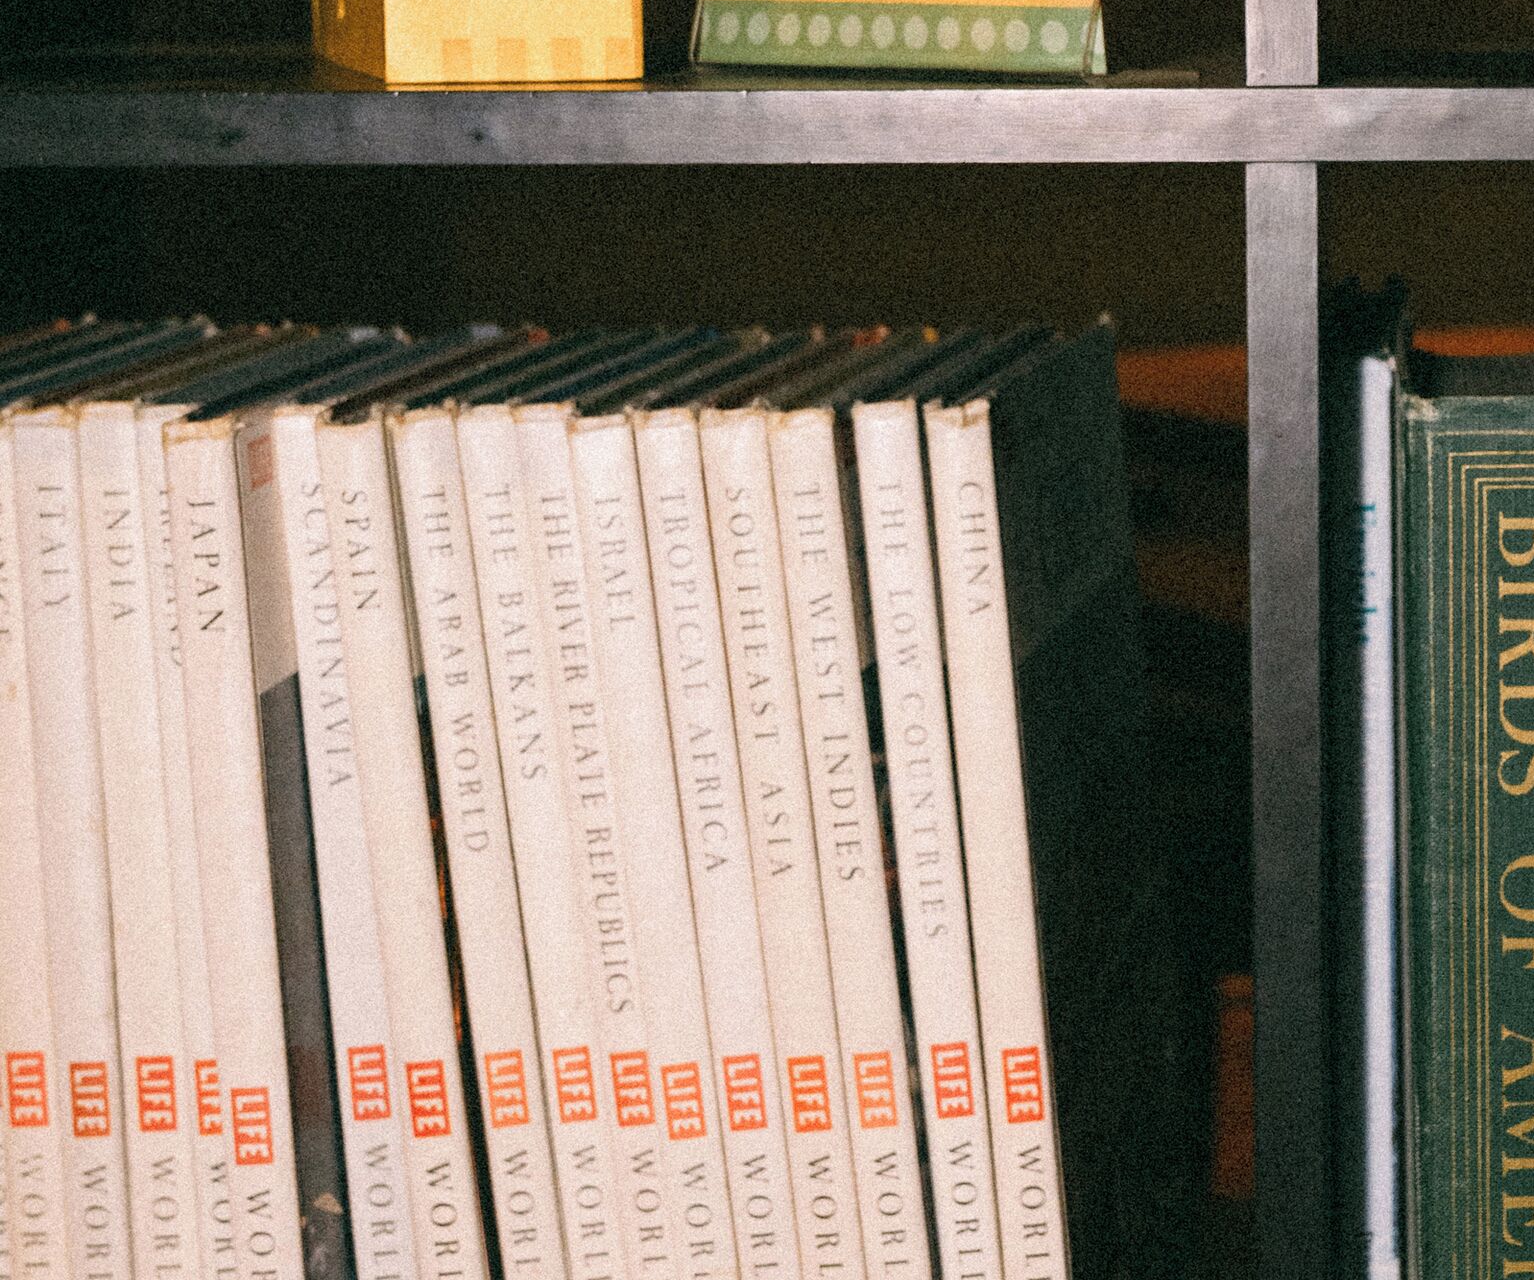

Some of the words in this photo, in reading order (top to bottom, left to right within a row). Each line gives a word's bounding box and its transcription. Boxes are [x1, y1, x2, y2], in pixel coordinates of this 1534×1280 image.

[36, 483, 72, 608] ITALY
[102, 488, 138, 622] INDIA
[186, 499, 227, 634] JAPAN
[339, 488, 383, 613] SPAIN
[421, 483, 455, 561] THE
[484, 482, 520, 565] THE
[539, 489, 575, 561] THE
[593, 495, 637, 634] ISRAEL
[792, 481, 829, 567] THE
[877, 481, 909, 559] THE
[956, 477, 994, 618] CHINA
[300, 482, 355, 789] SCANDINAVIA
[434, 586, 471, 688] ARAB
[498, 590, 549, 783] BALKANS
[551, 577, 590, 684] RIVER
[658, 490, 711, 701] TROPICAL
[687, 722, 732, 875] AFRICA
[724, 486, 780, 747] SOUTHEAST
[758, 779, 795, 879] ASIA
[807, 590, 846, 705] WEST
[887, 587, 922, 672] LOW
[449, 710, 492, 855] WORLD
[568, 700, 609, 810] PLATE
[821, 730, 867, 884] INDIES
[899, 690, 950, 942] COUNTRIES
[585, 824, 635, 1017] REPUBLICS
[347, 1043, 393, 1122] LIFE
[786, 1054, 833, 1135] LIFE
[1001, 1046, 1047, 1125] LIFE
